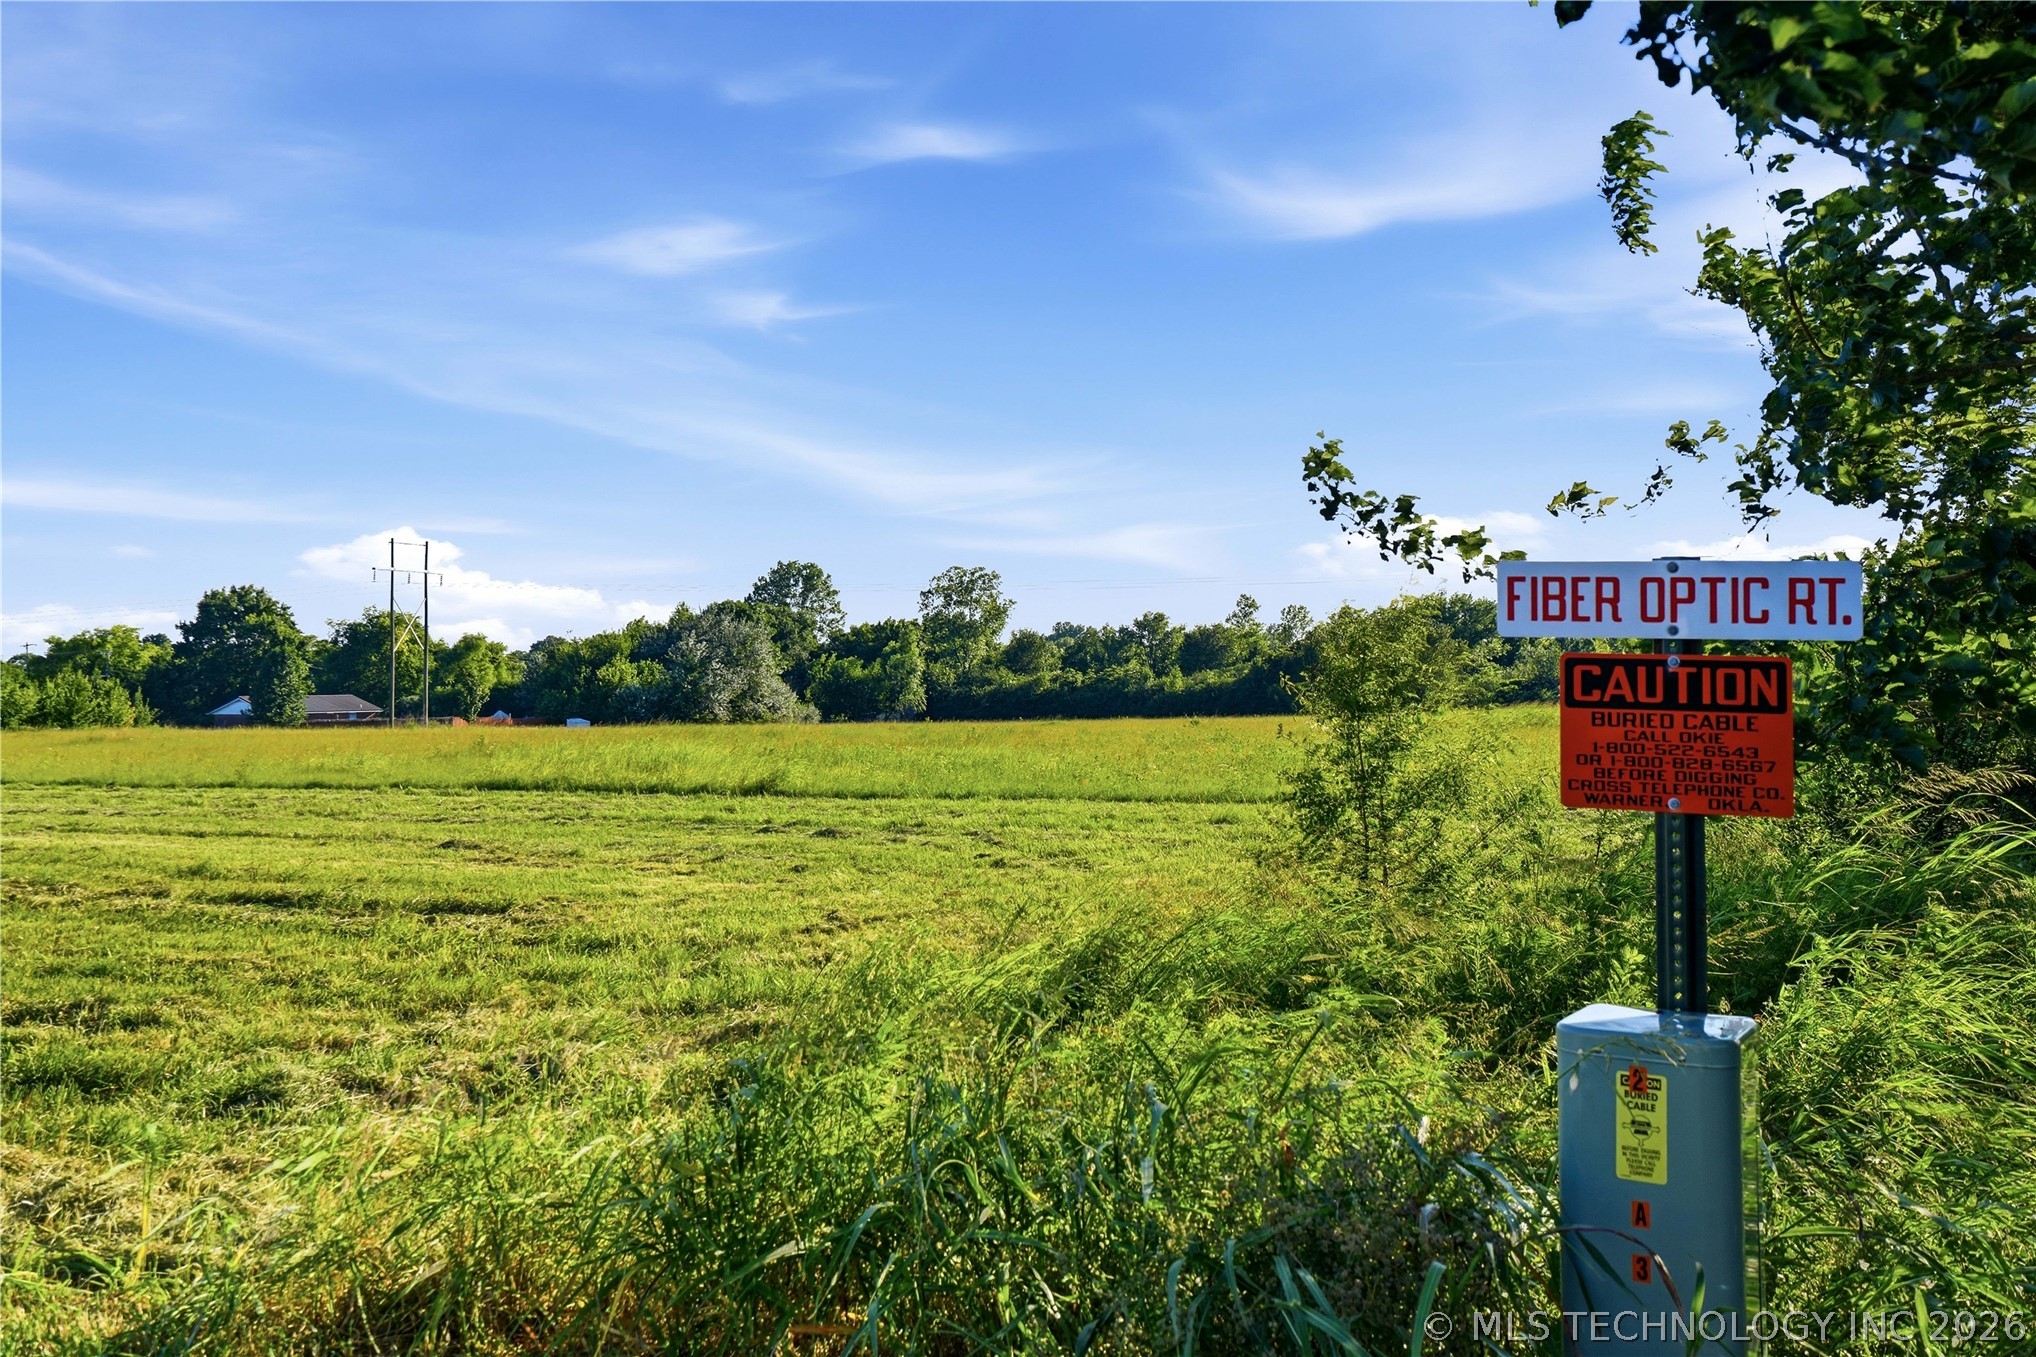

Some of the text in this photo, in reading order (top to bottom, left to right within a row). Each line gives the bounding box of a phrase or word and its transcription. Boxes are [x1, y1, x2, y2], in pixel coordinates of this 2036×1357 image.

[1506, 576, 1852, 625] FIBER OPTIC RT.
[1573, 664, 1778, 706] CAUTION
[1591, 711, 1759, 732] BURIED CABLE
[1624, 730, 1725, 745] CALL OKIE
[1592, 741, 1759, 759] 1-800-522-6543
[1576, 754, 1777, 773] OR 1-800-828-6567
[1593, 767, 1758, 786] BEFORE DIGGING
[1567, 779, 1785, 800] CROSS TELEPHONE CO.
[1707, 798, 1770, 813] OKLA.
[1632, 1068, 1643, 1091] 2
[1626, 1101, 1656, 1112] CABLE
[1635, 1203, 1647, 1227] A
[1636, 1256, 1648, 1280] 3
